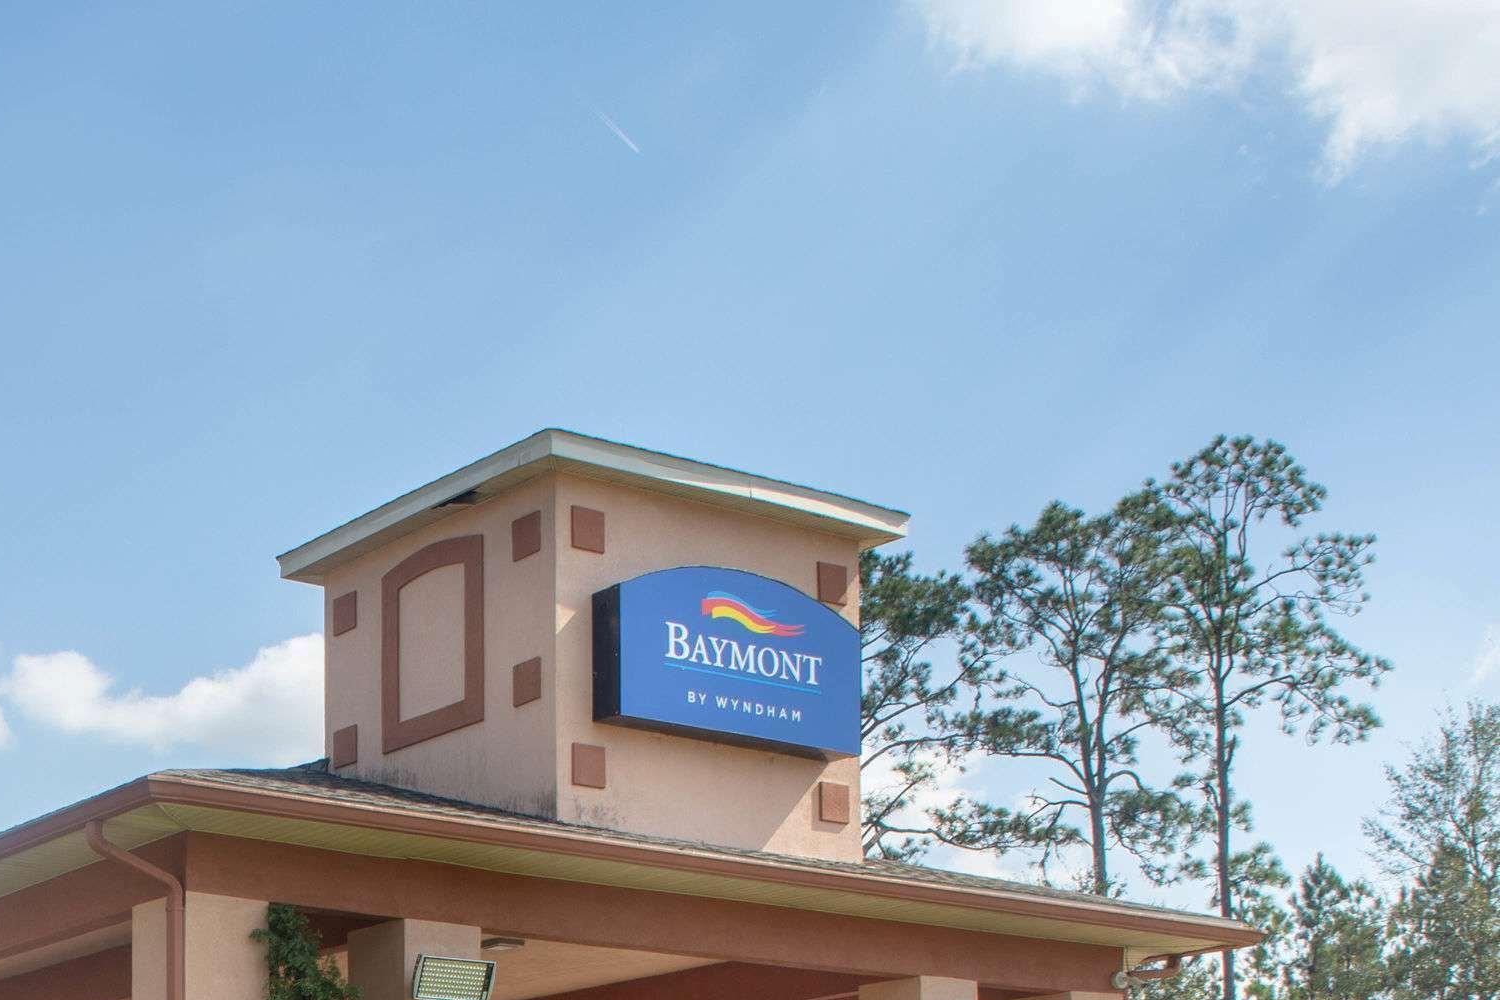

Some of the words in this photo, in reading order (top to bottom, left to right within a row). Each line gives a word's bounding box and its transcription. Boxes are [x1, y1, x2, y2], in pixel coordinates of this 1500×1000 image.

[665, 621, 822, 685] BAYMONT
[687, 691, 707, 705] BY
[716, 696, 802, 722] WYNDHAM
